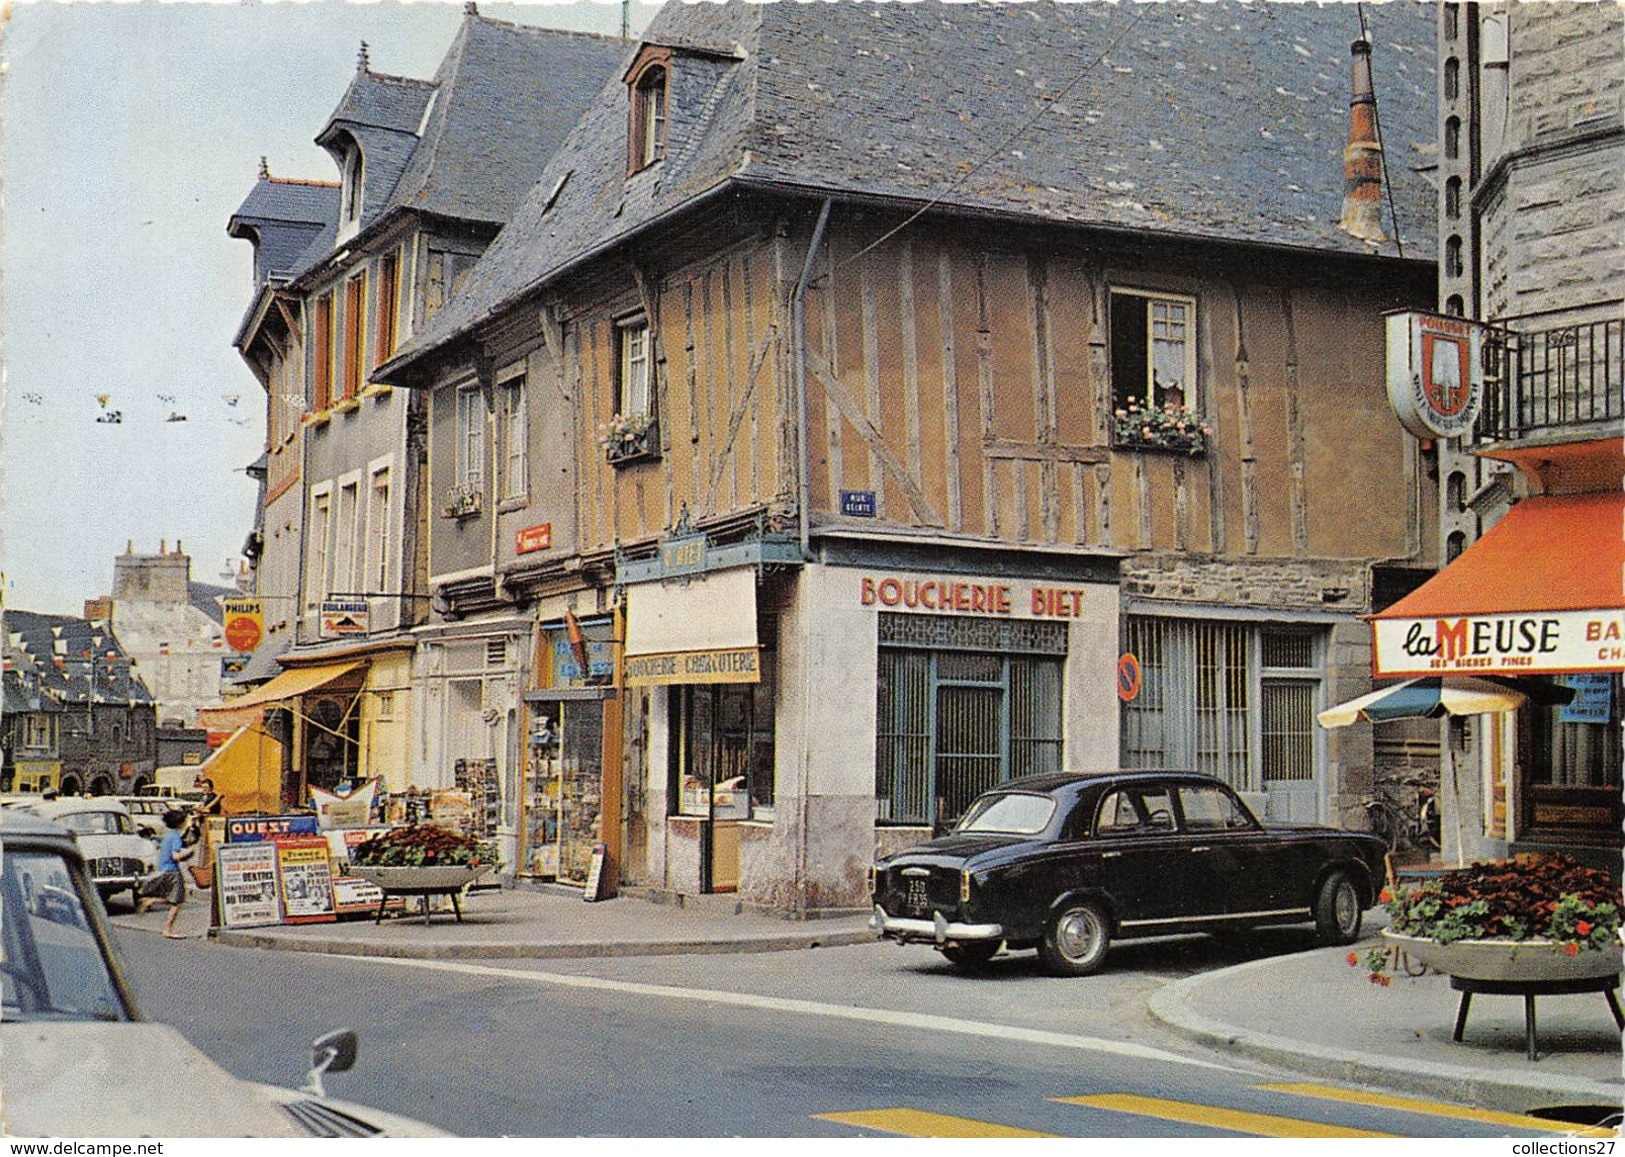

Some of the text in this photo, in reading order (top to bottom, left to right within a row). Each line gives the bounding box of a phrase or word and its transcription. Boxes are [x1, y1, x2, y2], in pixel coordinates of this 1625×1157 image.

[850, 494, 867, 502] RUE
[860, 576, 1084, 618] BOUCHERIE BIET
[225, 603, 261, 613] PHILIPS
[1598, 647, 1624, 660] CH
[1430, 658, 1447, 668] SES
[1501, 656, 1533, 667] FINES
[231, 821, 291, 835] OUEST
